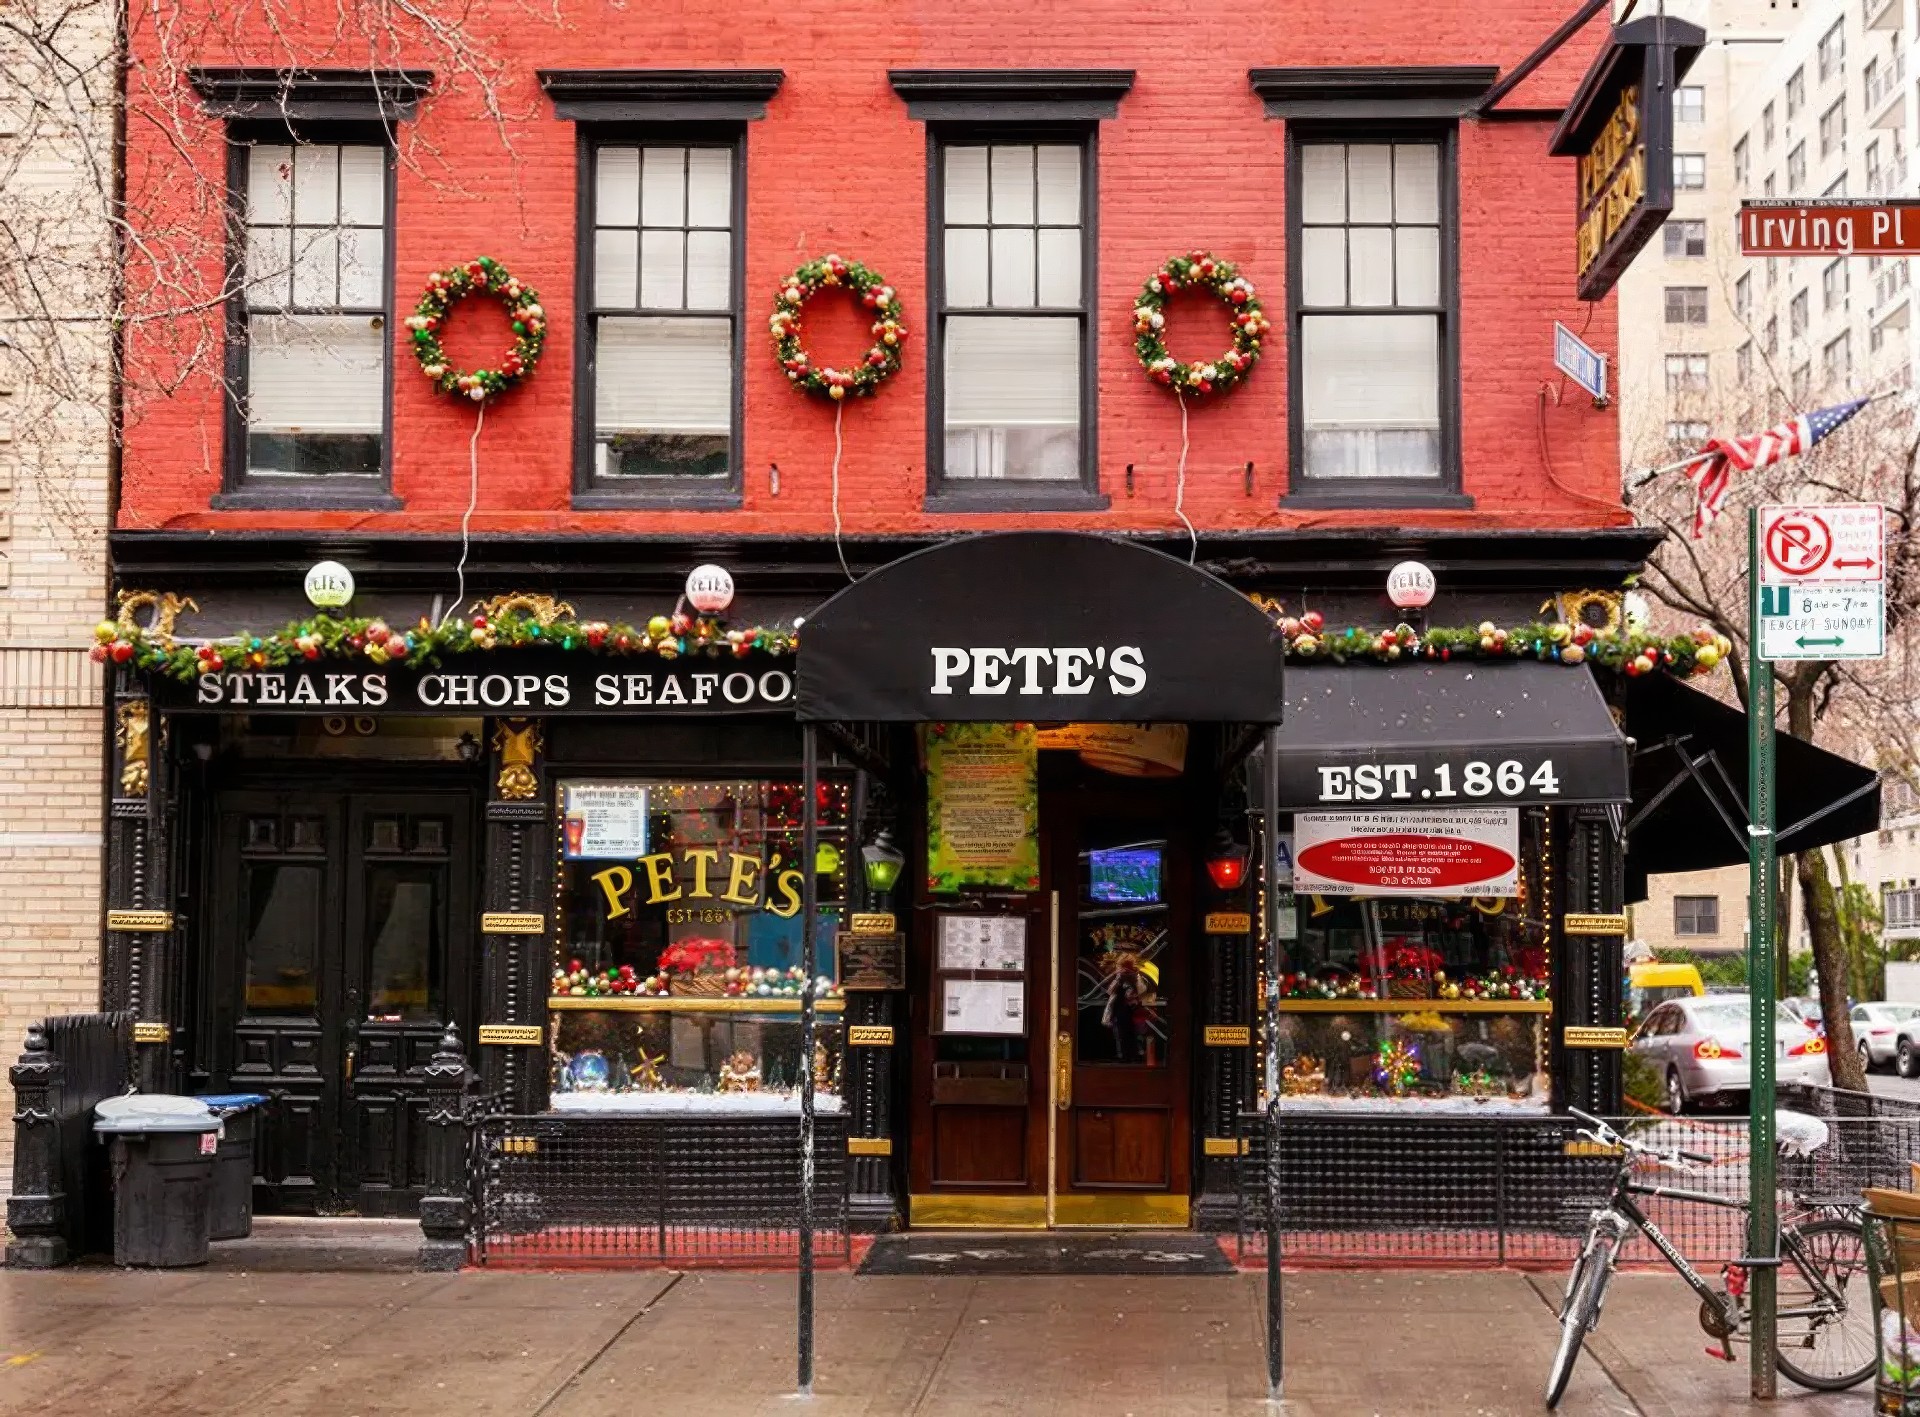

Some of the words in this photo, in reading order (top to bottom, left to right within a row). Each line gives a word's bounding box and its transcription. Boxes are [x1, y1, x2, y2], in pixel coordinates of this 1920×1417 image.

[1750, 209, 1853, 255] Irving
[1872, 209, 1904, 246] Pl
[198, 672, 389, 706] STEAKS
[417, 673, 570, 707] CHOPS
[595, 670, 798, 706] SEAFOO
[930, 645, 1147, 696] PETE'S
[1318, 759, 1560, 801] EST.1864
[591, 850, 804, 920] PETE'S
